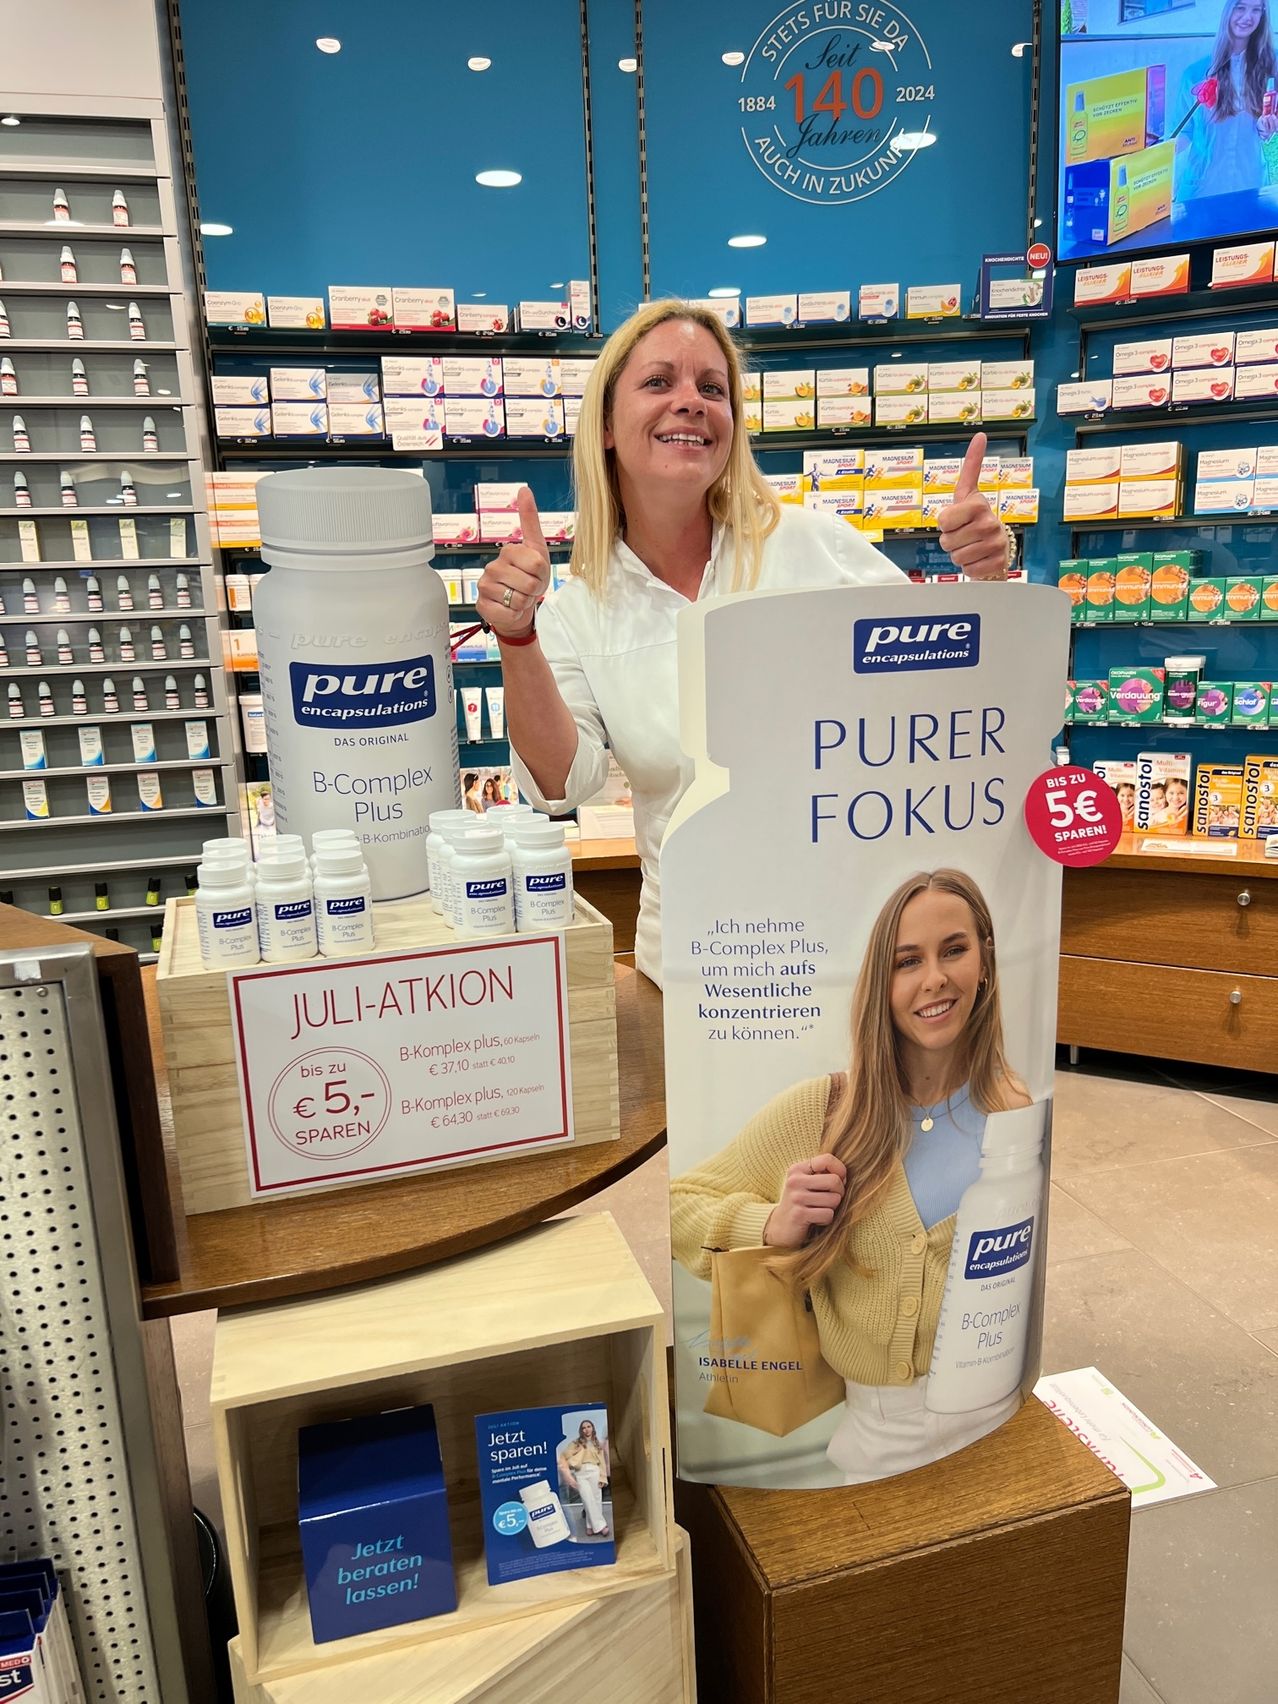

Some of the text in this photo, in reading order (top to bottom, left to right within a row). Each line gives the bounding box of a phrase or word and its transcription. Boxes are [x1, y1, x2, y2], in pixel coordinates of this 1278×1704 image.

[762, 0, 909, 61] STETS FÜR SIE DA
[805, 34, 862, 70] Seit
[783, 67, 883, 123] 140
[896, 85, 935, 102] 2024
[738, 96, 776, 112] 1884
[786, 113, 886, 160] Jahren
[755, 137, 798, 184] AUCH
[802, 175, 824, 194] IN
[864, 619, 972, 653] pure
[862, 647, 969, 665] encapsulations
[302, 666, 428, 703] pure
[1110, 692, 1161, 701] Verdauung
[1234, 698, 1257, 706] Schlaf
[301, 698, 428, 720] encapsulations
[334, 733, 409, 747] DAS ORIGINAL
[812, 706, 1006, 770] PURER
[313, 766, 433, 796] B-Complex
[1046, 773, 1086, 788] BIS ZU
[1138, 759, 1152, 830] sanostol
[1197, 770, 1210, 833] sanostol
[1244, 763, 1260, 835] sanostol
[354, 801, 404, 823] Plus
[810, 777, 1005, 844] FOKUS
[1045, 790, 1103, 828] 5€
[355, 824, 431, 844] -B-Kombinatio
[1054, 825, 1107, 842] SPAREN!
[470, 880, 505, 892] pure
[529, 874, 564, 886] pure
[278, 902, 310, 914] pure
[329, 898, 363, 910] pure
[471, 906, 505, 914] B-Complex
[530, 900, 565, 908] B-Complex
[216, 910, 250, 923] pure
[280, 926, 311, 936] B-Complex
[332, 922, 364, 931] B-Complex
[707, 918, 805, 936] „Ich nehme
[691, 938, 828, 959] B-Complex Plus,
[702, 960, 816, 977] um mich aufs
[705, 982, 812, 998] Wesentliche
[290, 965, 514, 1041] JULI-ATKION
[699, 1004, 821, 1019] konzentrieren
[708, 1028, 727, 1040] zu
[400, 1033, 540, 1061] B-Komplex plus, 60 Kapseln
[300, 1062, 346, 1078] bis zu
[429, 1064, 438, 1076] €
[292, 1097, 316, 1119] €
[401, 1084, 545, 1115] B-Komplex plus, 120 Kapseln
[431, 1117, 440, 1128] €
[476, 1113, 492, 1121] statt
[494, 1110, 499, 1118] €
[295, 1120, 371, 1146] SPAREN
[972, 1225, 1032, 1261] pure
[969, 1249, 1029, 1271] encapsulations
[981, 1277, 1015, 1292] DAS ORIGINAL
[961, 1302, 1021, 1330] B-Complex
[977, 1330, 1003, 1349] Plus
[699, 1357, 802, 1370] ISABELLE ENGEL
[699, 1372, 738, 1383] Athletin
[488, 1430, 526, 1446] Jetzt
[490, 1442, 547, 1464] sparen!
[351, 1534, 405, 1561] Jetzt
[337, 1554, 423, 1585] beraten
[346, 1573, 420, 1605] lassen!
